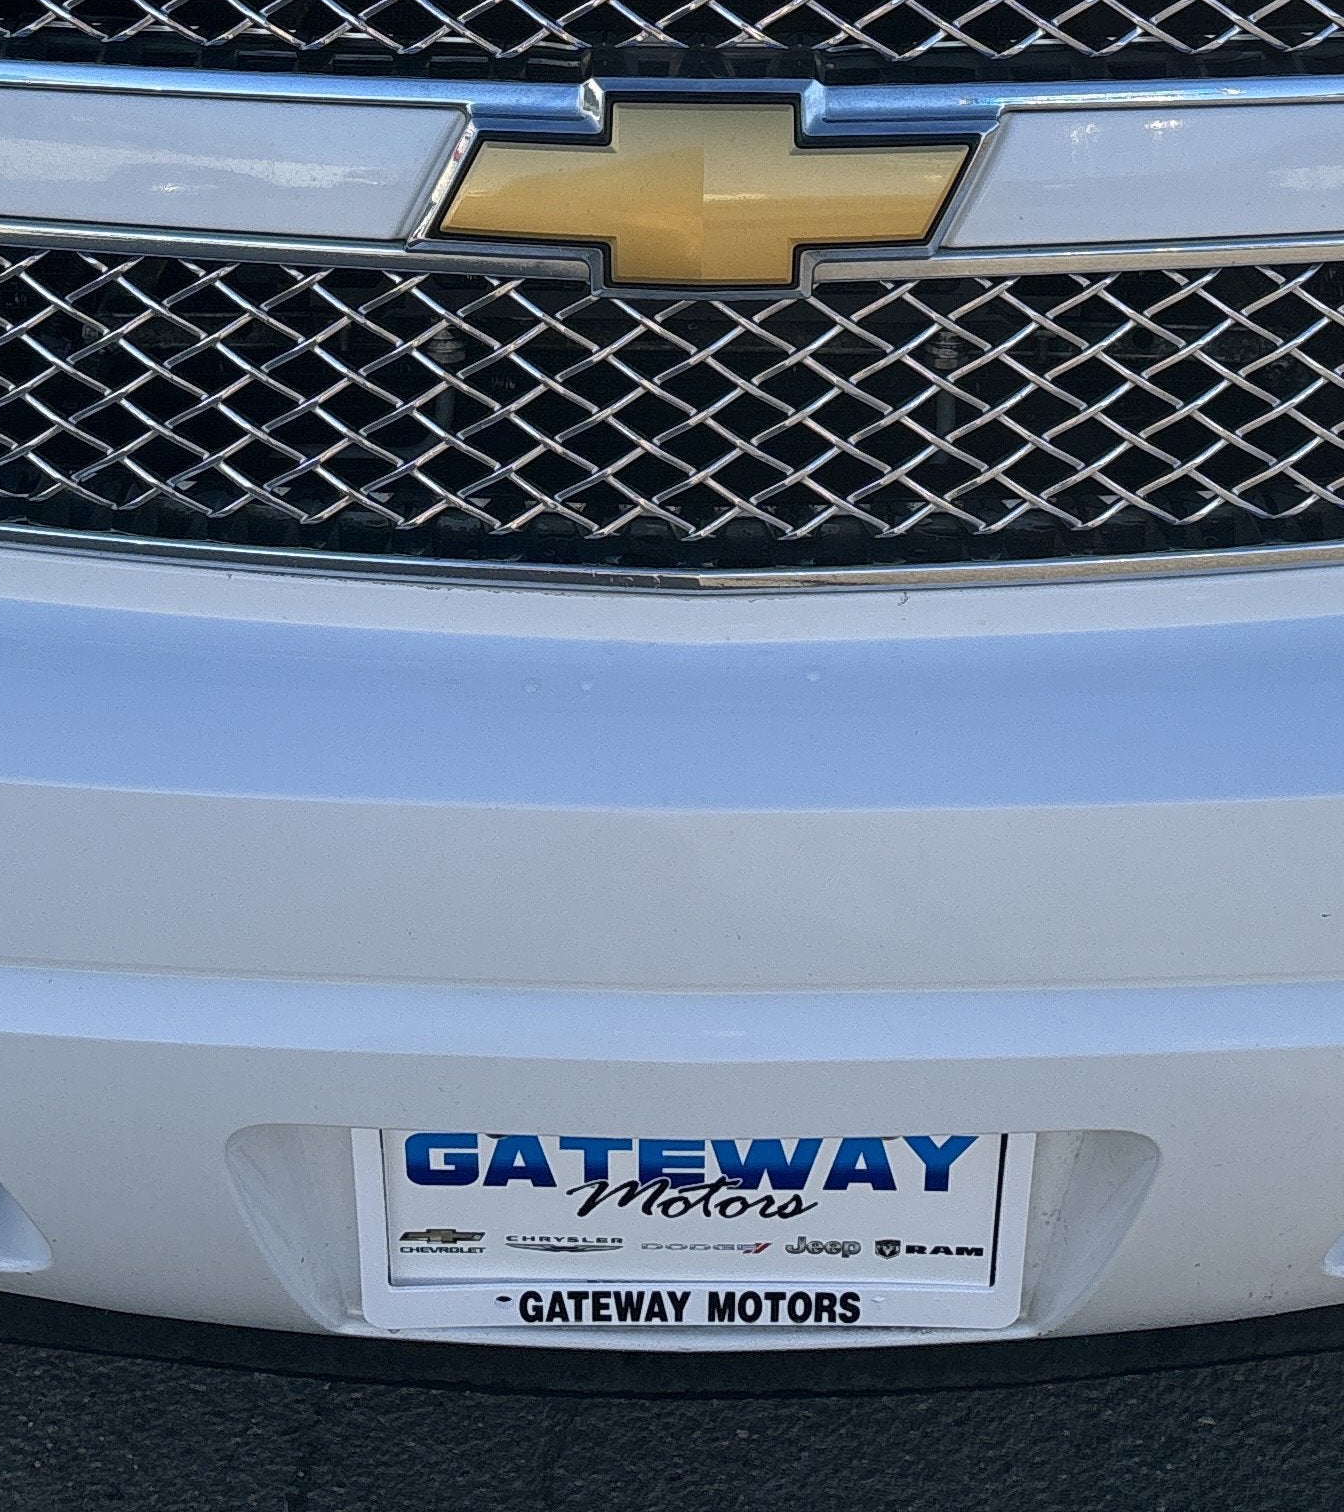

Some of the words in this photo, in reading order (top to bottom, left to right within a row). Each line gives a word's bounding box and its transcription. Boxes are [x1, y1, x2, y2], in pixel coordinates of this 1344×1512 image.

[404, 1132, 980, 1192] GATEWAY
[565, 1175, 819, 1219] Motors
[399, 1245, 486, 1254] CHEVROLET
[506, 1234, 624, 1244] CHRYSLER
[784, 1236, 862, 1258] Jeep
[905, 1244, 984, 1257] RAM
[518, 1290, 692, 1323] GATEWAY
[707, 1291, 861, 1324] MOTORS
